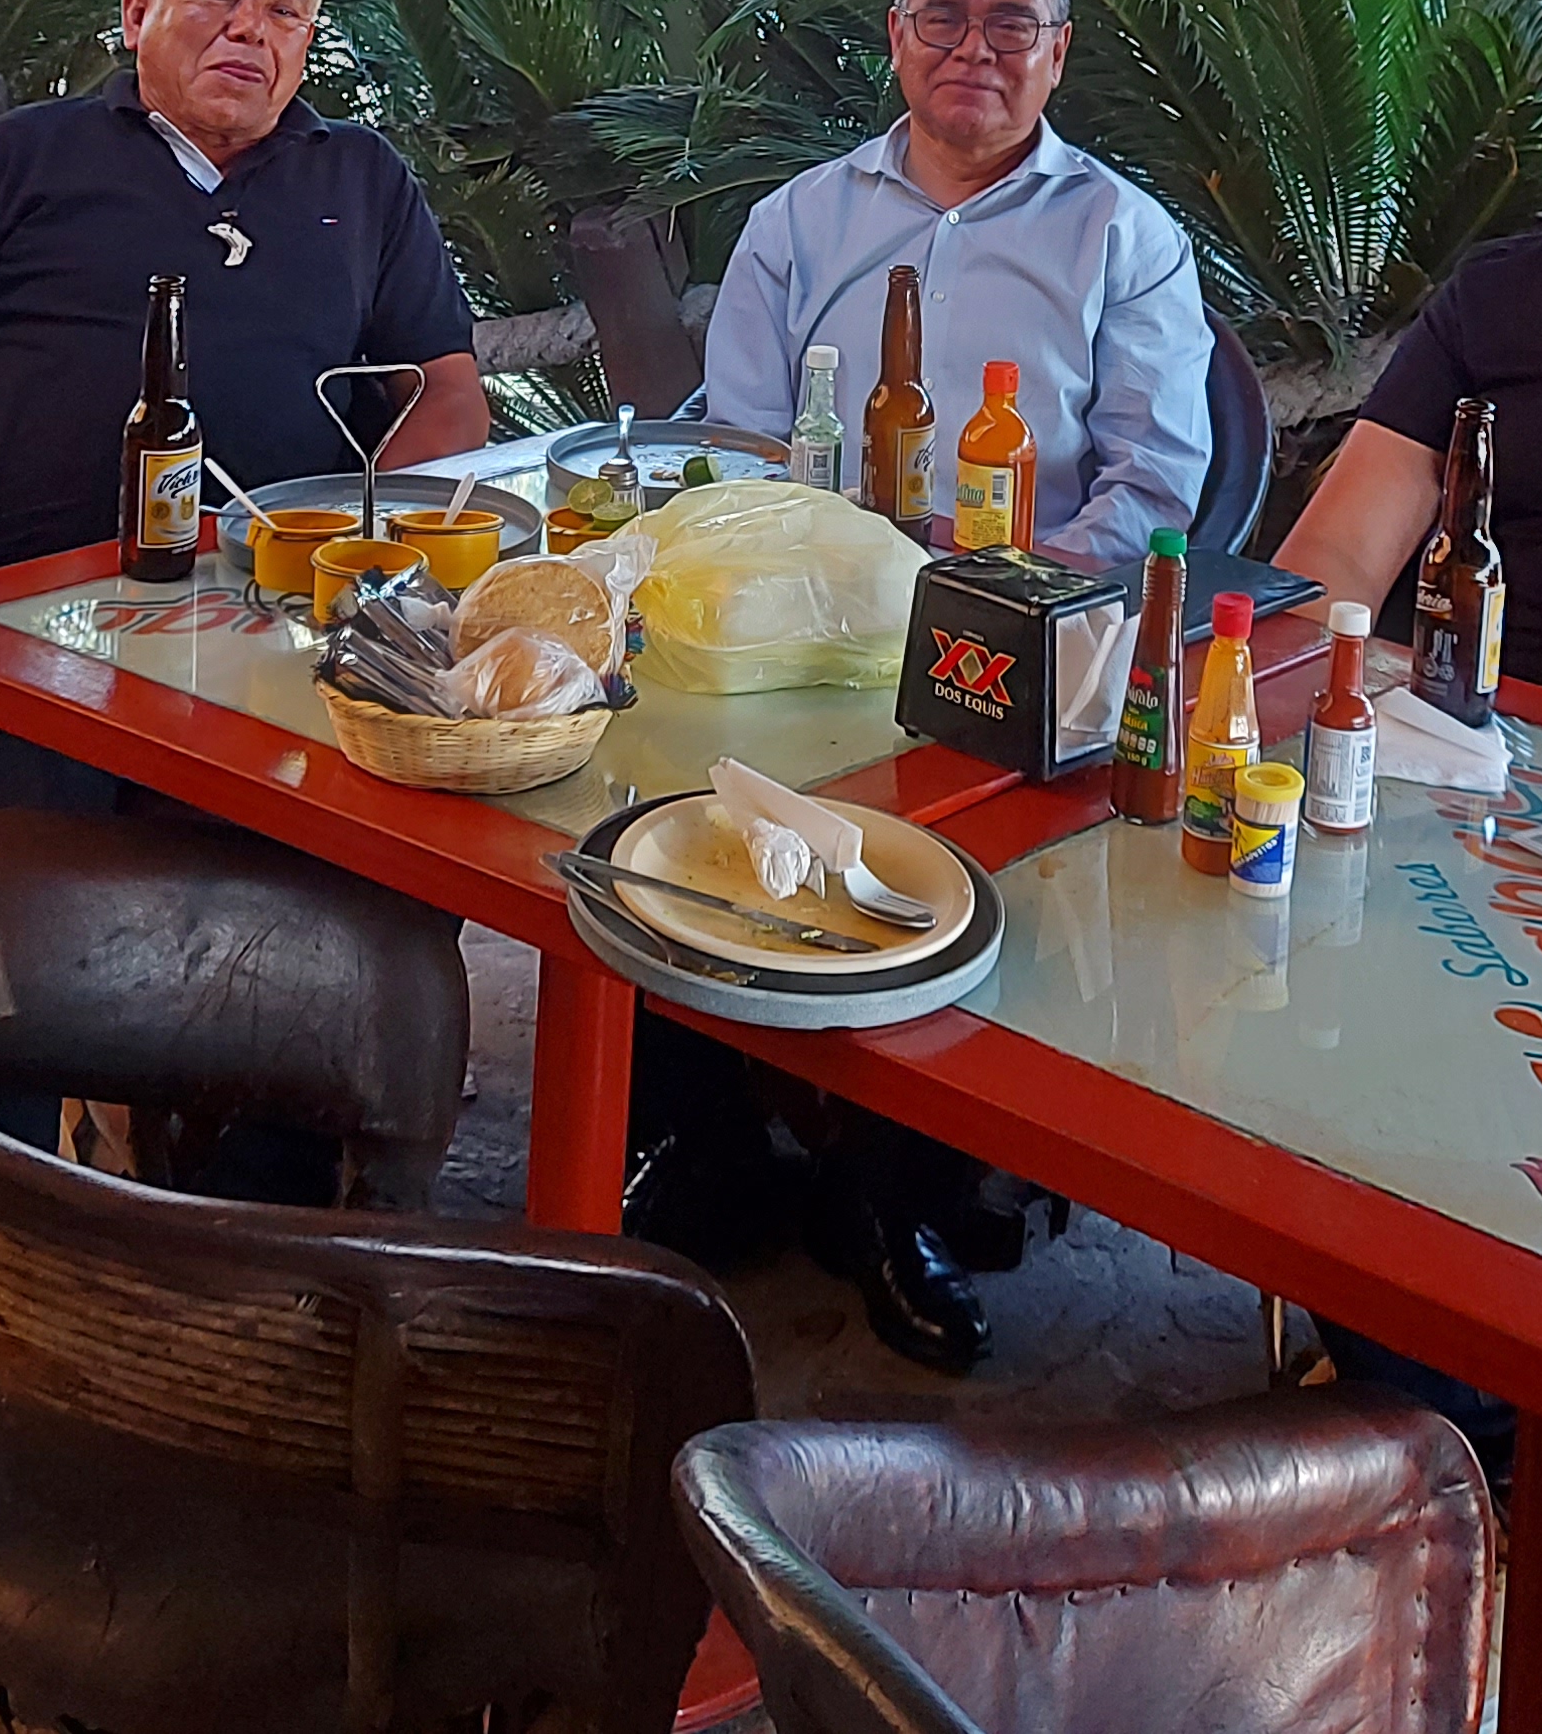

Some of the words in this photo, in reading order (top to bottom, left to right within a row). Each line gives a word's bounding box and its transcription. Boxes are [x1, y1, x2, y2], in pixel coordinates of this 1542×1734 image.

[934, 682, 962, 704] DOS
[964, 693, 1005, 720] EQUIS
[1394, 863, 1529, 986] Sabores
